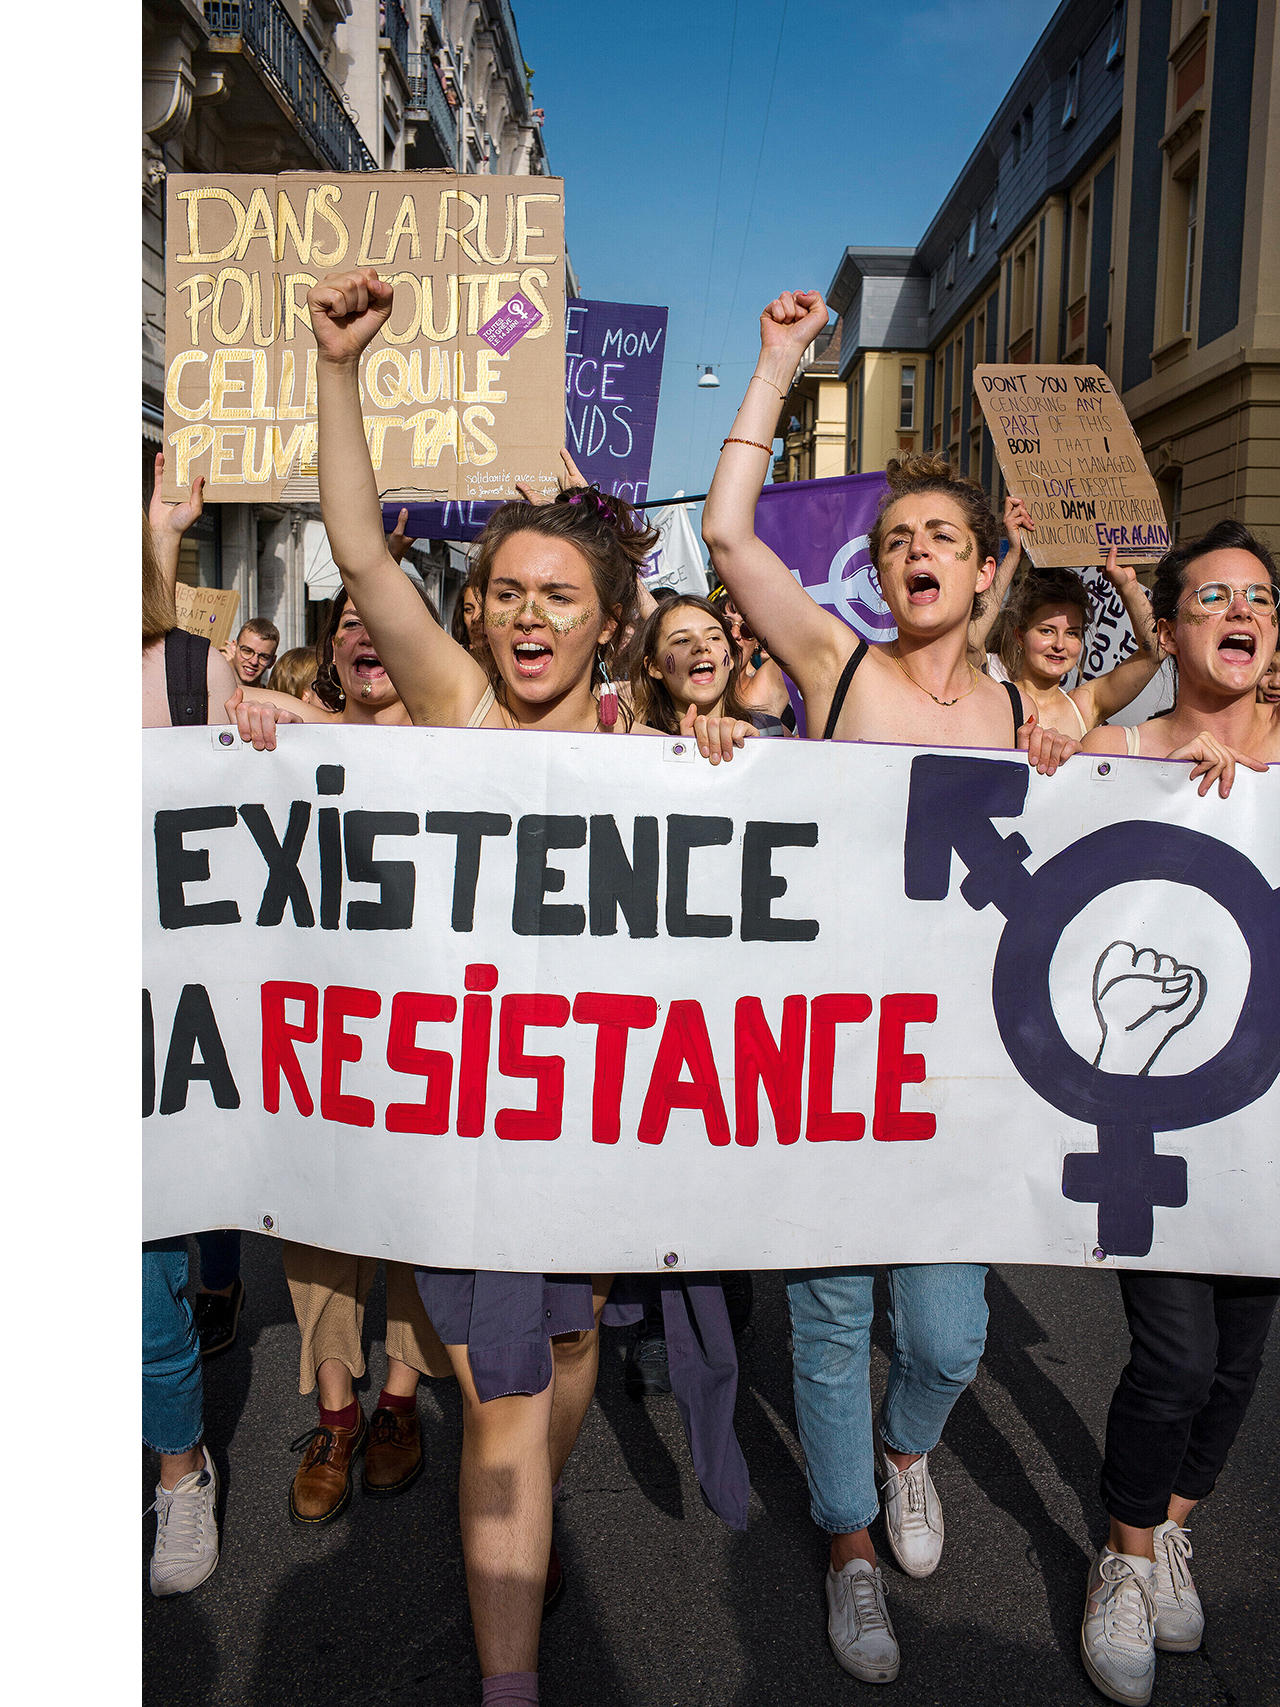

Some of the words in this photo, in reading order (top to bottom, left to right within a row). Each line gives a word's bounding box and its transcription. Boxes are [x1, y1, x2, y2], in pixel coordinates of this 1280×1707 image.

[175, 184, 350, 268] DANS
[356, 190, 422, 267] LA
[434, 189, 562, 266] RUE
[377, 268, 553, 345] OUTES
[601, 327, 663, 359] MON
[166, 348, 365, 422] CELL
[981, 374, 1028, 395] DON'T
[1035, 374, 1068, 394] YOU
[1074, 376, 1112, 394] DARE
[989, 396, 1067, 413] CENSORING
[1076, 396, 1103, 413] ANY
[999, 414, 1041, 437] PART
[1048, 415, 1064, 433] OF
[1076, 414, 1113, 433] THIS
[167, 414, 406, 487] PEUVT
[401, 405, 500, 470] PAS
[1007, 438, 1041, 455] BODY
[1054, 438, 1093, 453] THAT
[1103, 436, 1111, 454] I
[1014, 458, 1073, 477] FINALLY
[1076, 455, 1138, 474] MANAGED
[513, 474, 537, 483] avec
[1017, 479, 1041, 497] TO
[1042, 477, 1081, 498] LOVE
[1080, 476, 1135, 498] DESPITE
[1025, 501, 1061, 521] YOUR
[1061, 500, 1097, 521] DAMN
[1095, 522, 1132, 546] EVER
[1131, 524, 1170, 546] AGAIN
